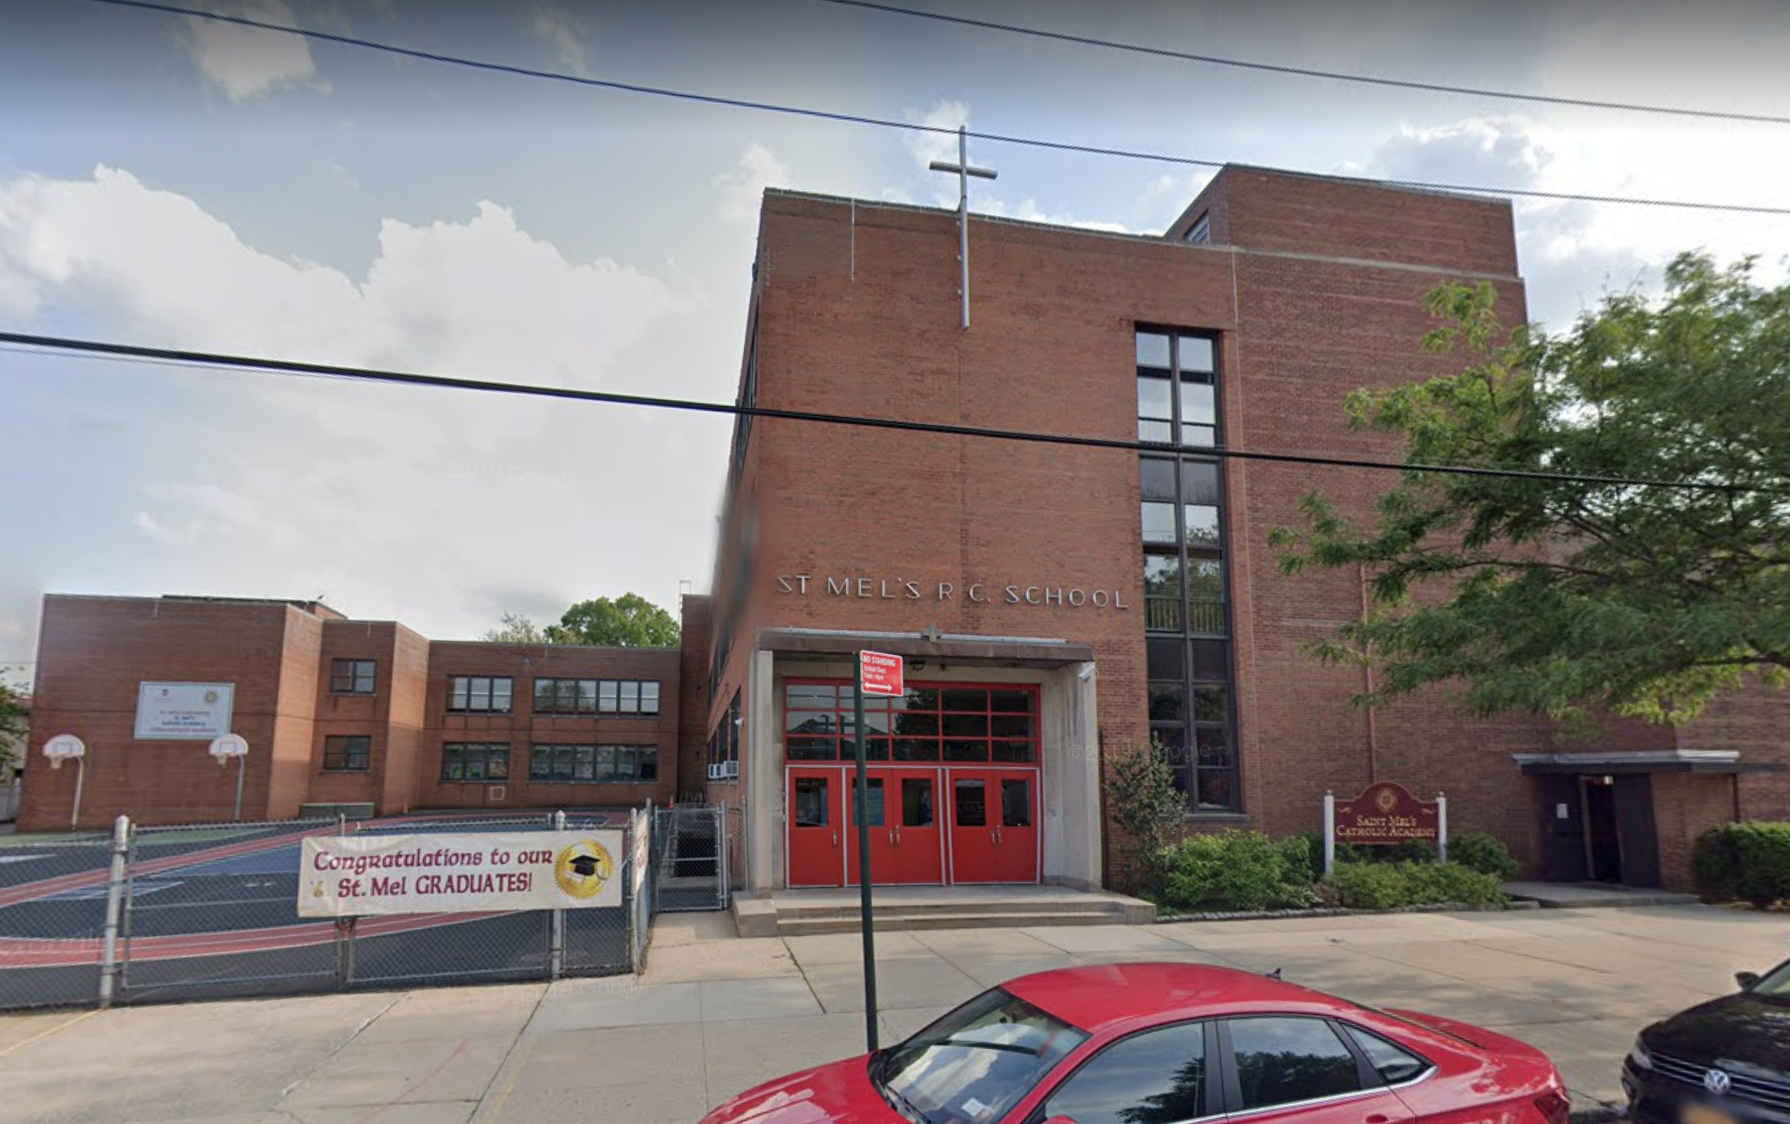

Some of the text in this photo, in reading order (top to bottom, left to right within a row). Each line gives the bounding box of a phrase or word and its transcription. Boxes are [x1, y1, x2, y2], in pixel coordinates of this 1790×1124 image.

[777, 574, 812, 595] ST
[827, 576, 921, 600] MEL'S
[1005, 585, 1130, 610] SCHOOL
[863, 655, 896, 667] NO STANDING
[314, 848, 553, 875] Congratulations to our
[337, 872, 533, 898] St. Mel GRADUATES!
